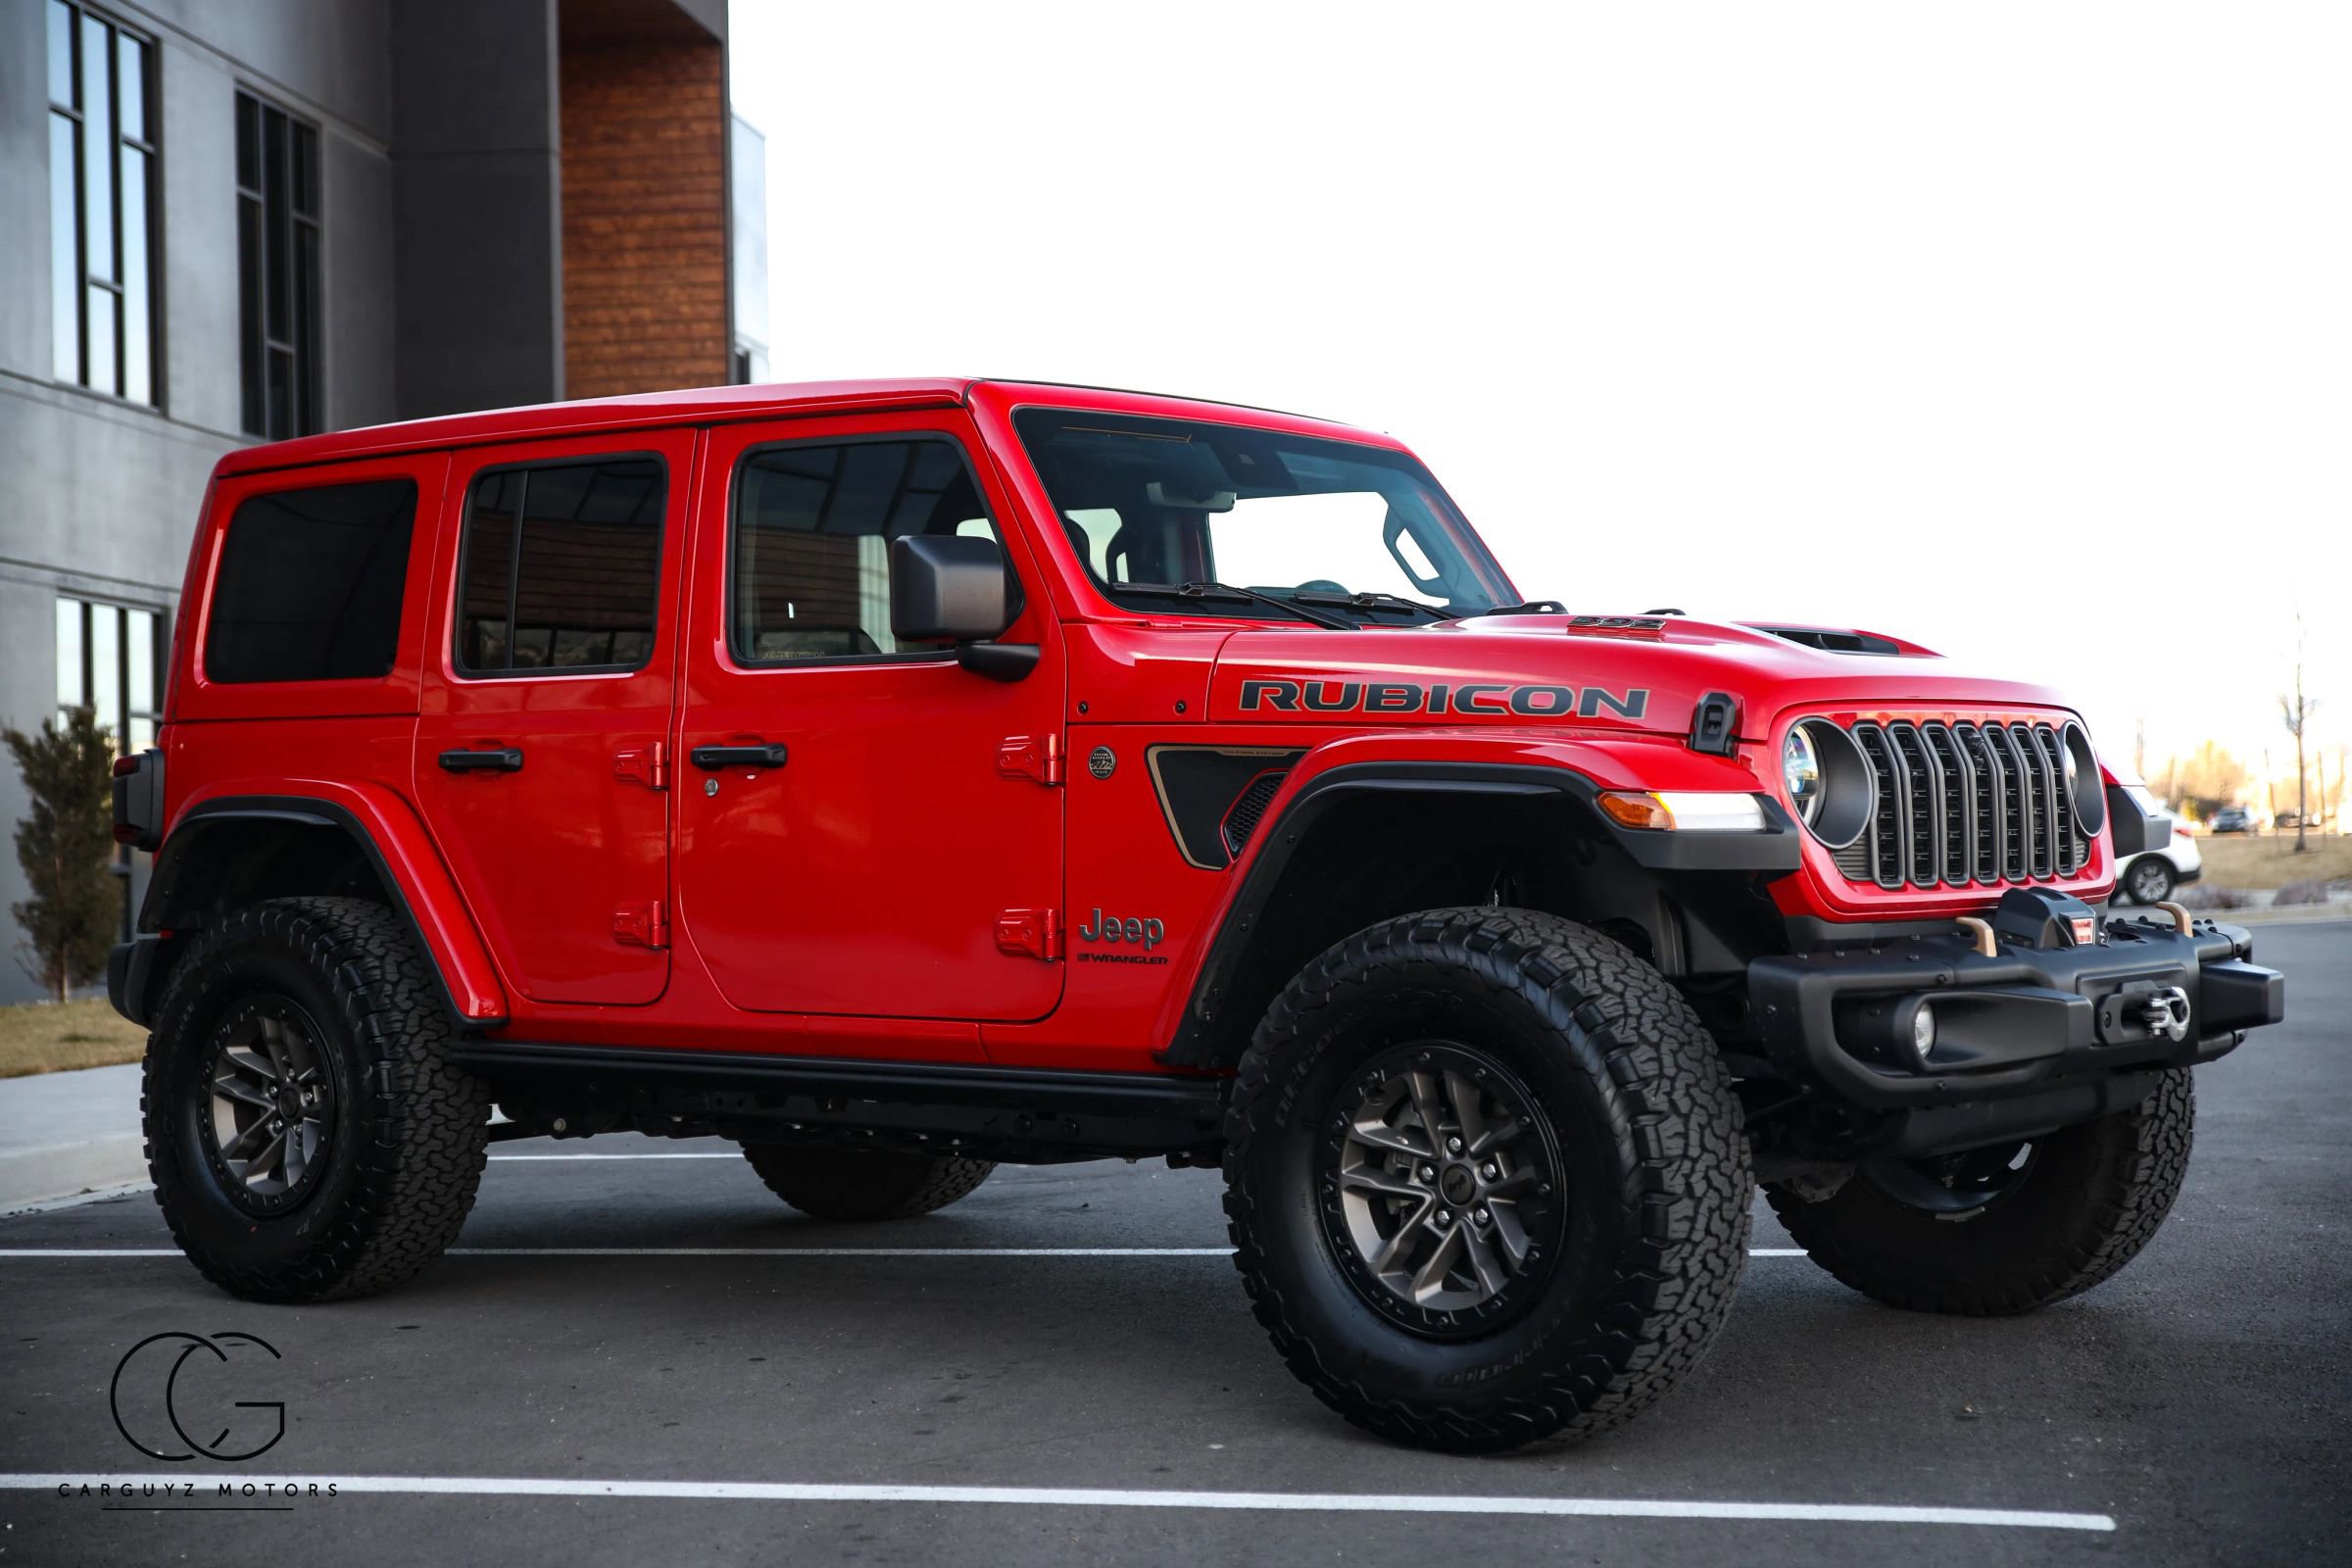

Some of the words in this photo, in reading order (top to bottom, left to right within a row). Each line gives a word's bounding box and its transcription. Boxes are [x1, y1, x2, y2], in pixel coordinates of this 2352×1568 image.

[1239, 680, 1649, 718] RUBICON
[1079, 907, 1164, 951] Jeep
[1090, 954, 1169, 965] WRANGLER
